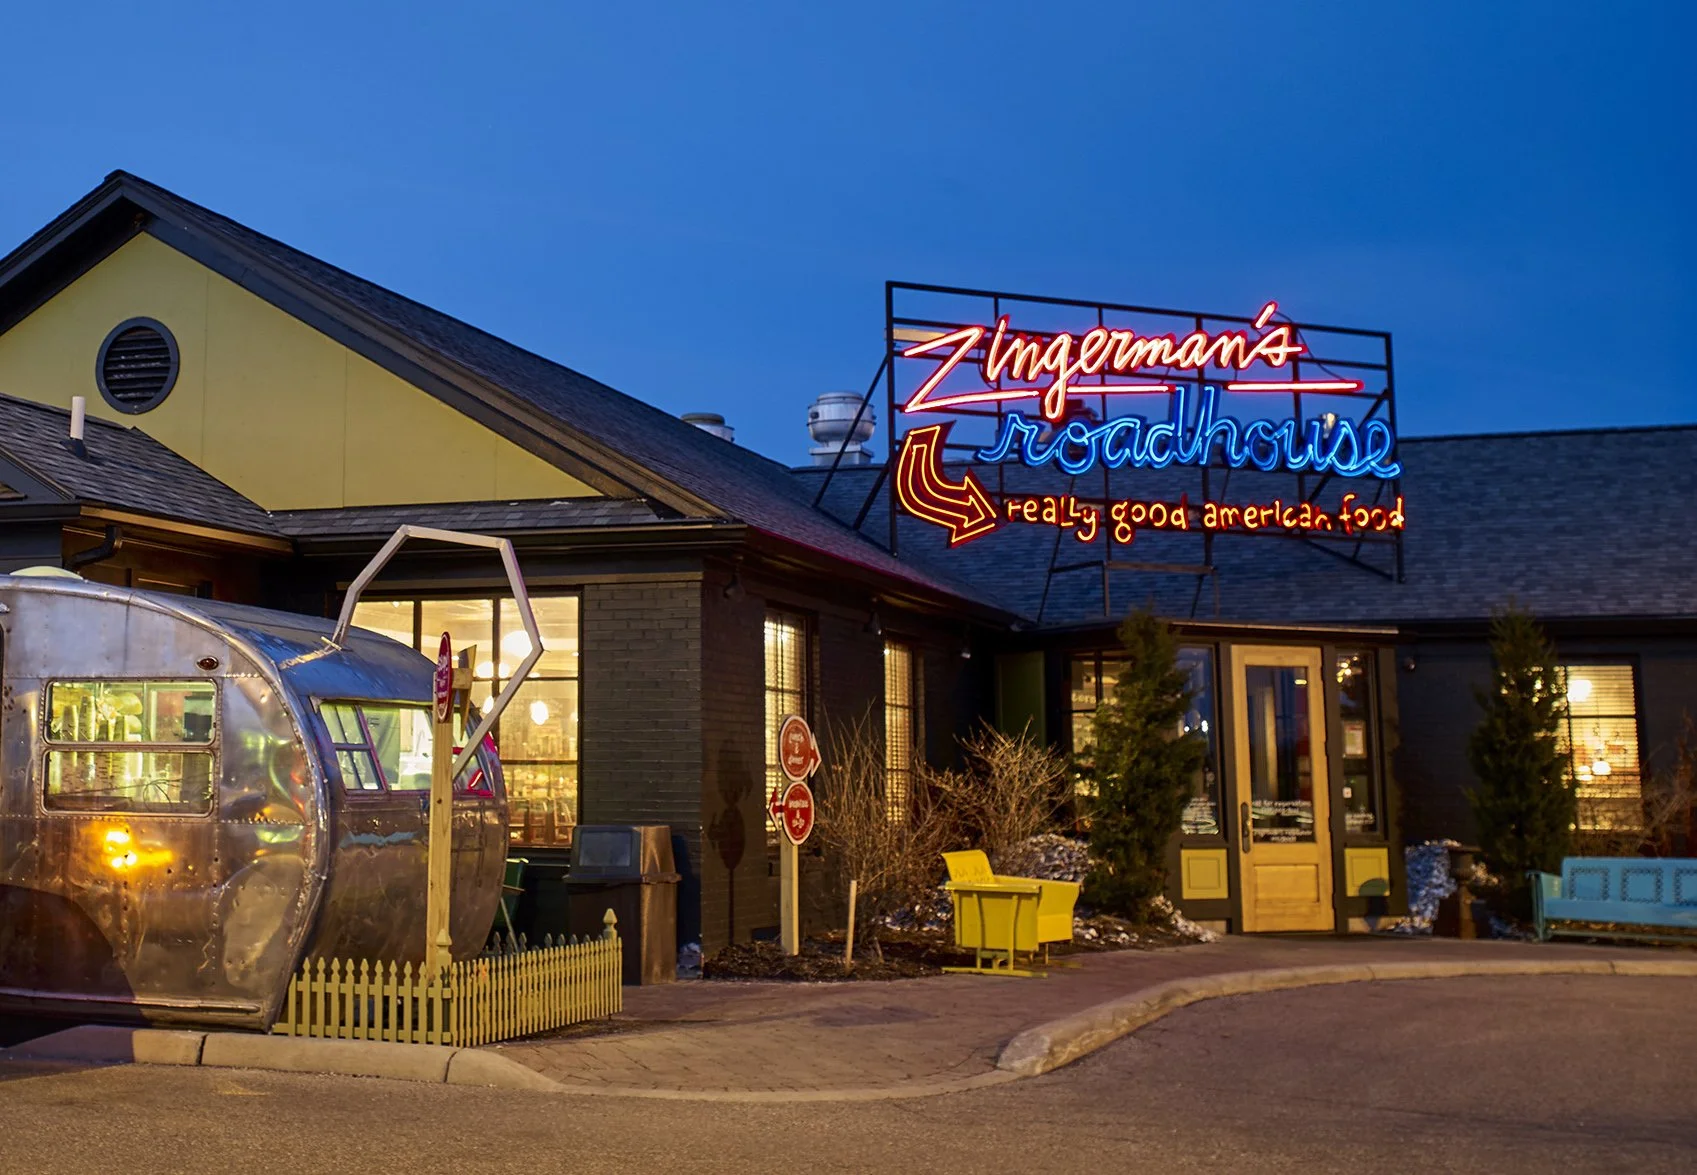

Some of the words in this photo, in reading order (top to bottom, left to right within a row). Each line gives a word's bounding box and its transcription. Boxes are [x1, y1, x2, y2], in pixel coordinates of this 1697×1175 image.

[902, 301, 1308, 422] Zingerman's
[976, 384, 1404, 479] roadhouse
[1111, 492, 1190, 544] good
[1202, 498, 1333, 531] american
[1338, 492, 1405, 535] food
